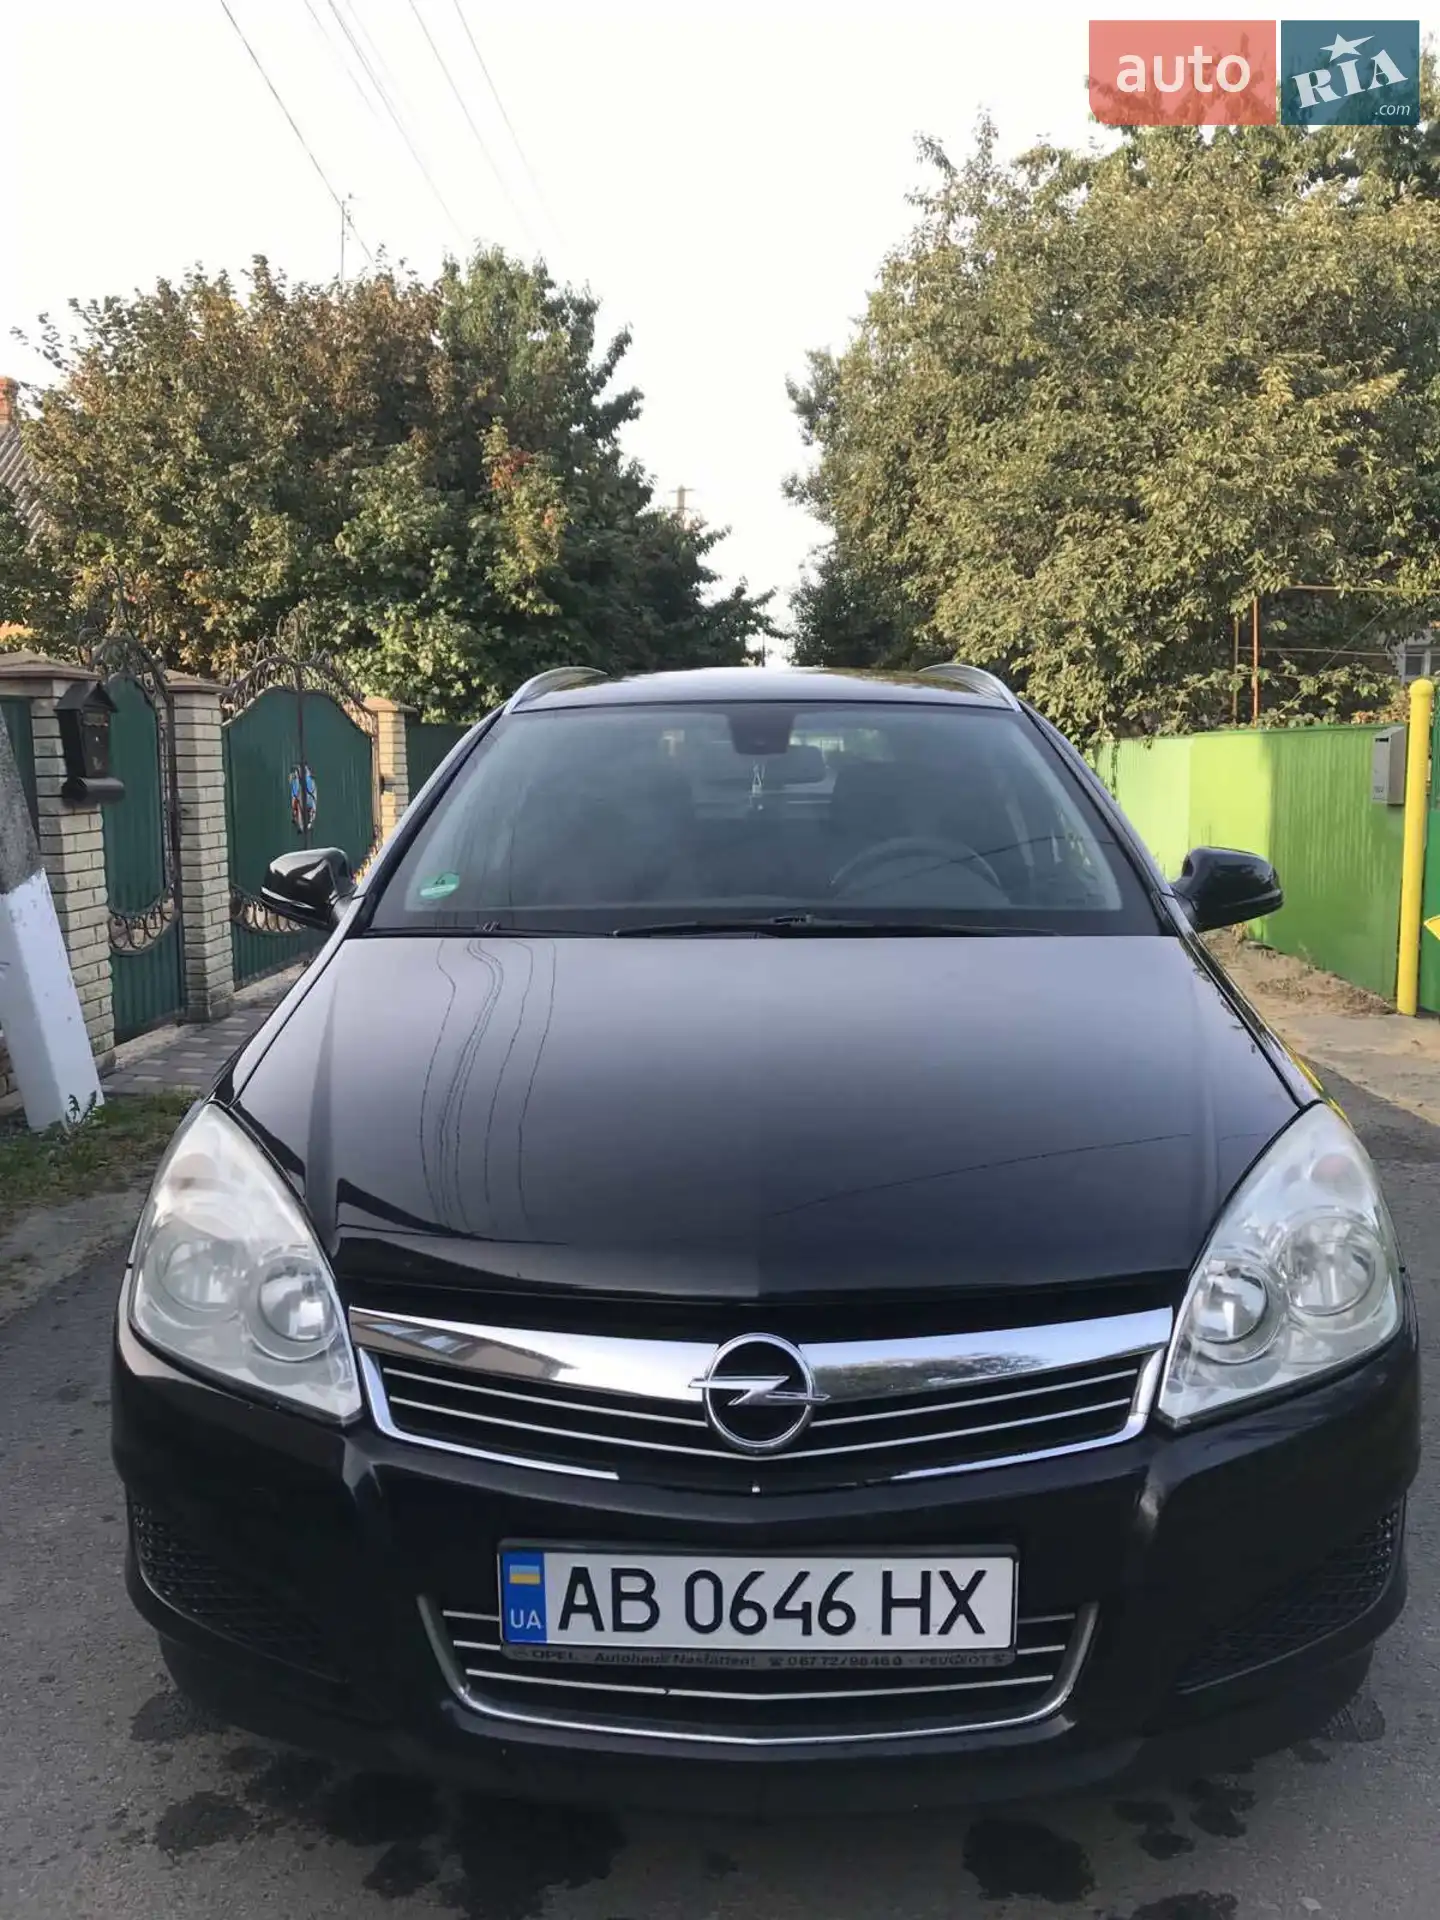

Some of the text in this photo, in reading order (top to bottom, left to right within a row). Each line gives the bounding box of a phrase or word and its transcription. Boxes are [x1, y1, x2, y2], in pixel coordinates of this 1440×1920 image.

[557, 1566, 987, 1636] AB 0646 HX
[509, 1609, 543, 1630] UA
[532, 1649, 578, 1660] OPEL
